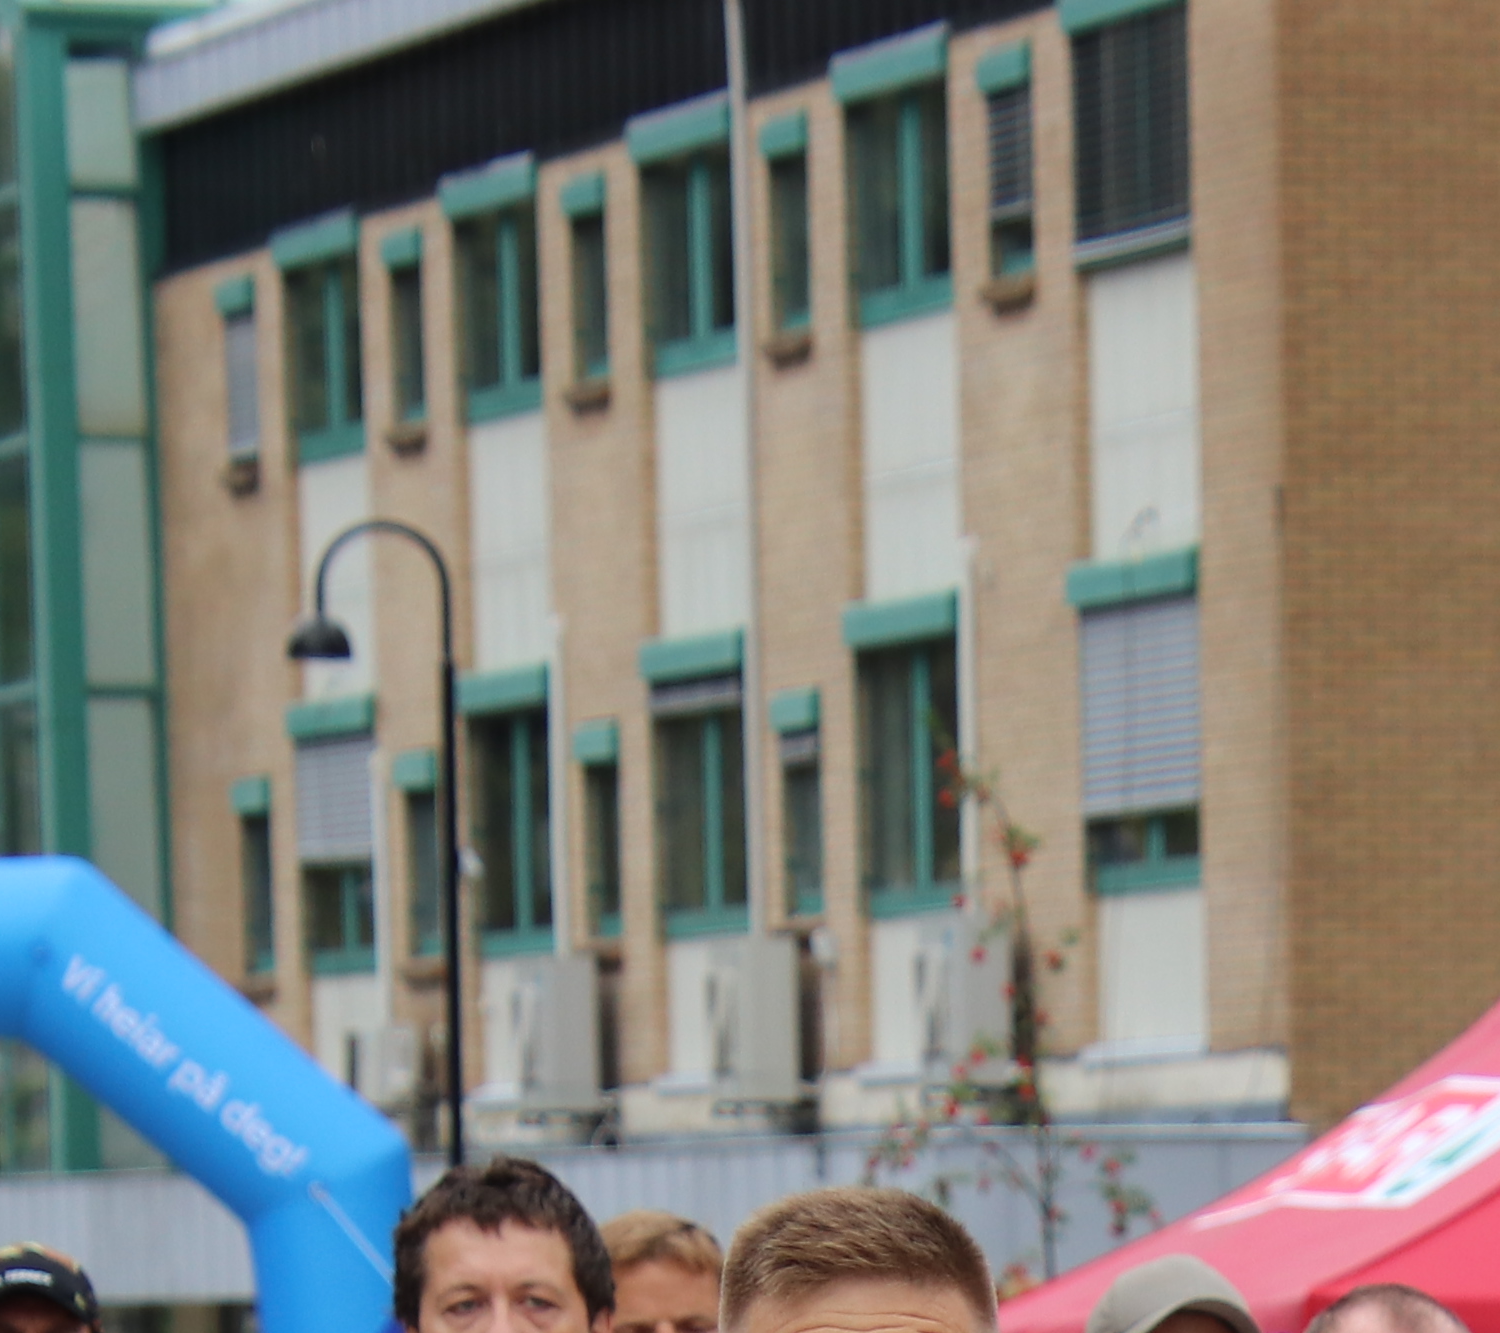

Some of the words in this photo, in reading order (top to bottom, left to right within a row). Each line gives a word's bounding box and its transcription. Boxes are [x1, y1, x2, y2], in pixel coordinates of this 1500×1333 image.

[62, 954, 106, 1000] Vi
[93, 983, 180, 1068] heiar
[168, 1059, 229, 1110] på
